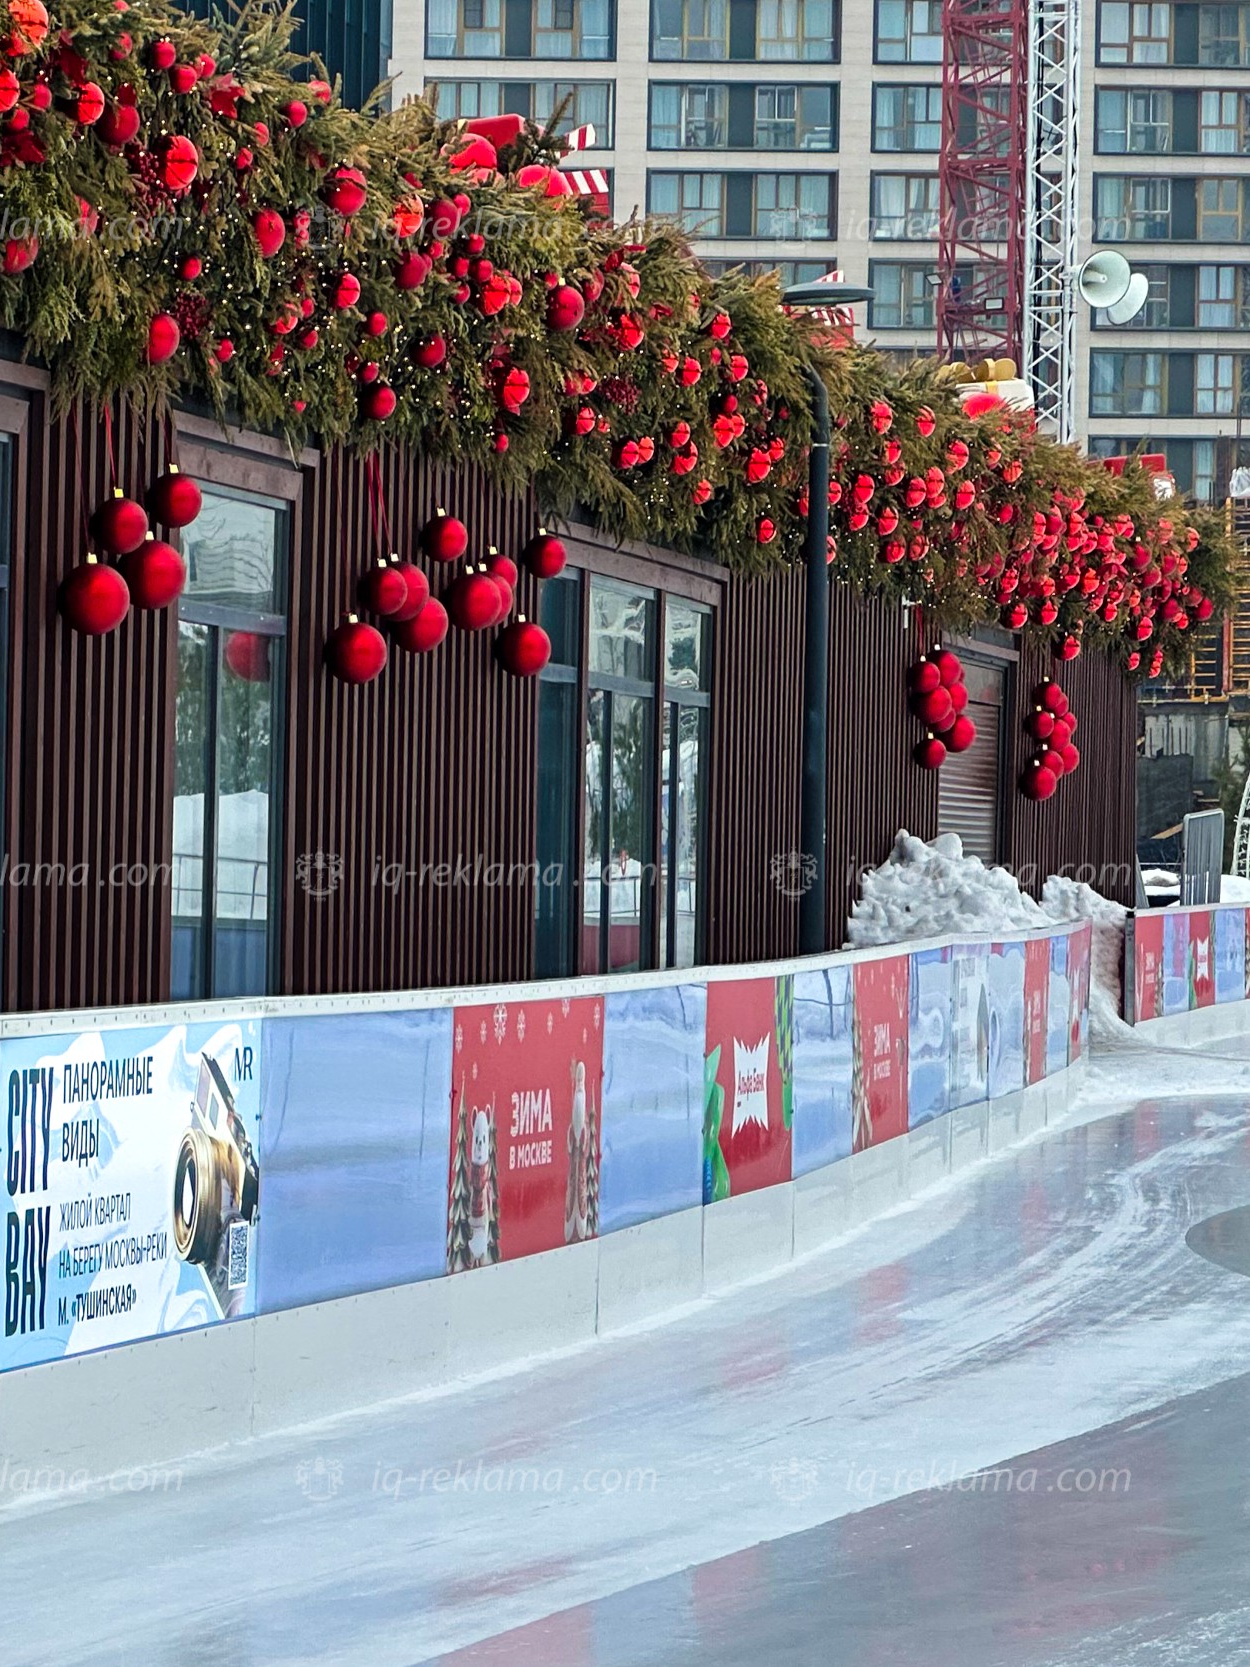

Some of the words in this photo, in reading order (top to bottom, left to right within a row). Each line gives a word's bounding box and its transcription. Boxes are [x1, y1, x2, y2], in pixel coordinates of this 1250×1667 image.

[63, 1056, 154, 1104] ПАНОРАМНЫЕ
[234, 1046, 253, 1082] MR
[7, 1066, 54, 1197] CITY
[510, 1088, 553, 1138] ЗИМА
[61, 1118, 100, 1168] ВИДЫ
[509, 1145, 516, 1171] В
[517, 1140, 553, 1168] МОСКВЕ
[59, 1193, 93, 1233] ЖИЛОЙ
[94, 1192, 132, 1227] КВАРТАЛ
[5, 1205, 51, 1338] BAY
[58, 1249, 72, 1279] НА
[72, 1242, 104, 1277] БЕРЕГУ
[104, 1231, 168, 1271] МОСКВЫ-РЕКИ
[57, 1295, 70, 1327] М.
[71, 1283, 138, 1323] «ТУШИНСКАЯ»
